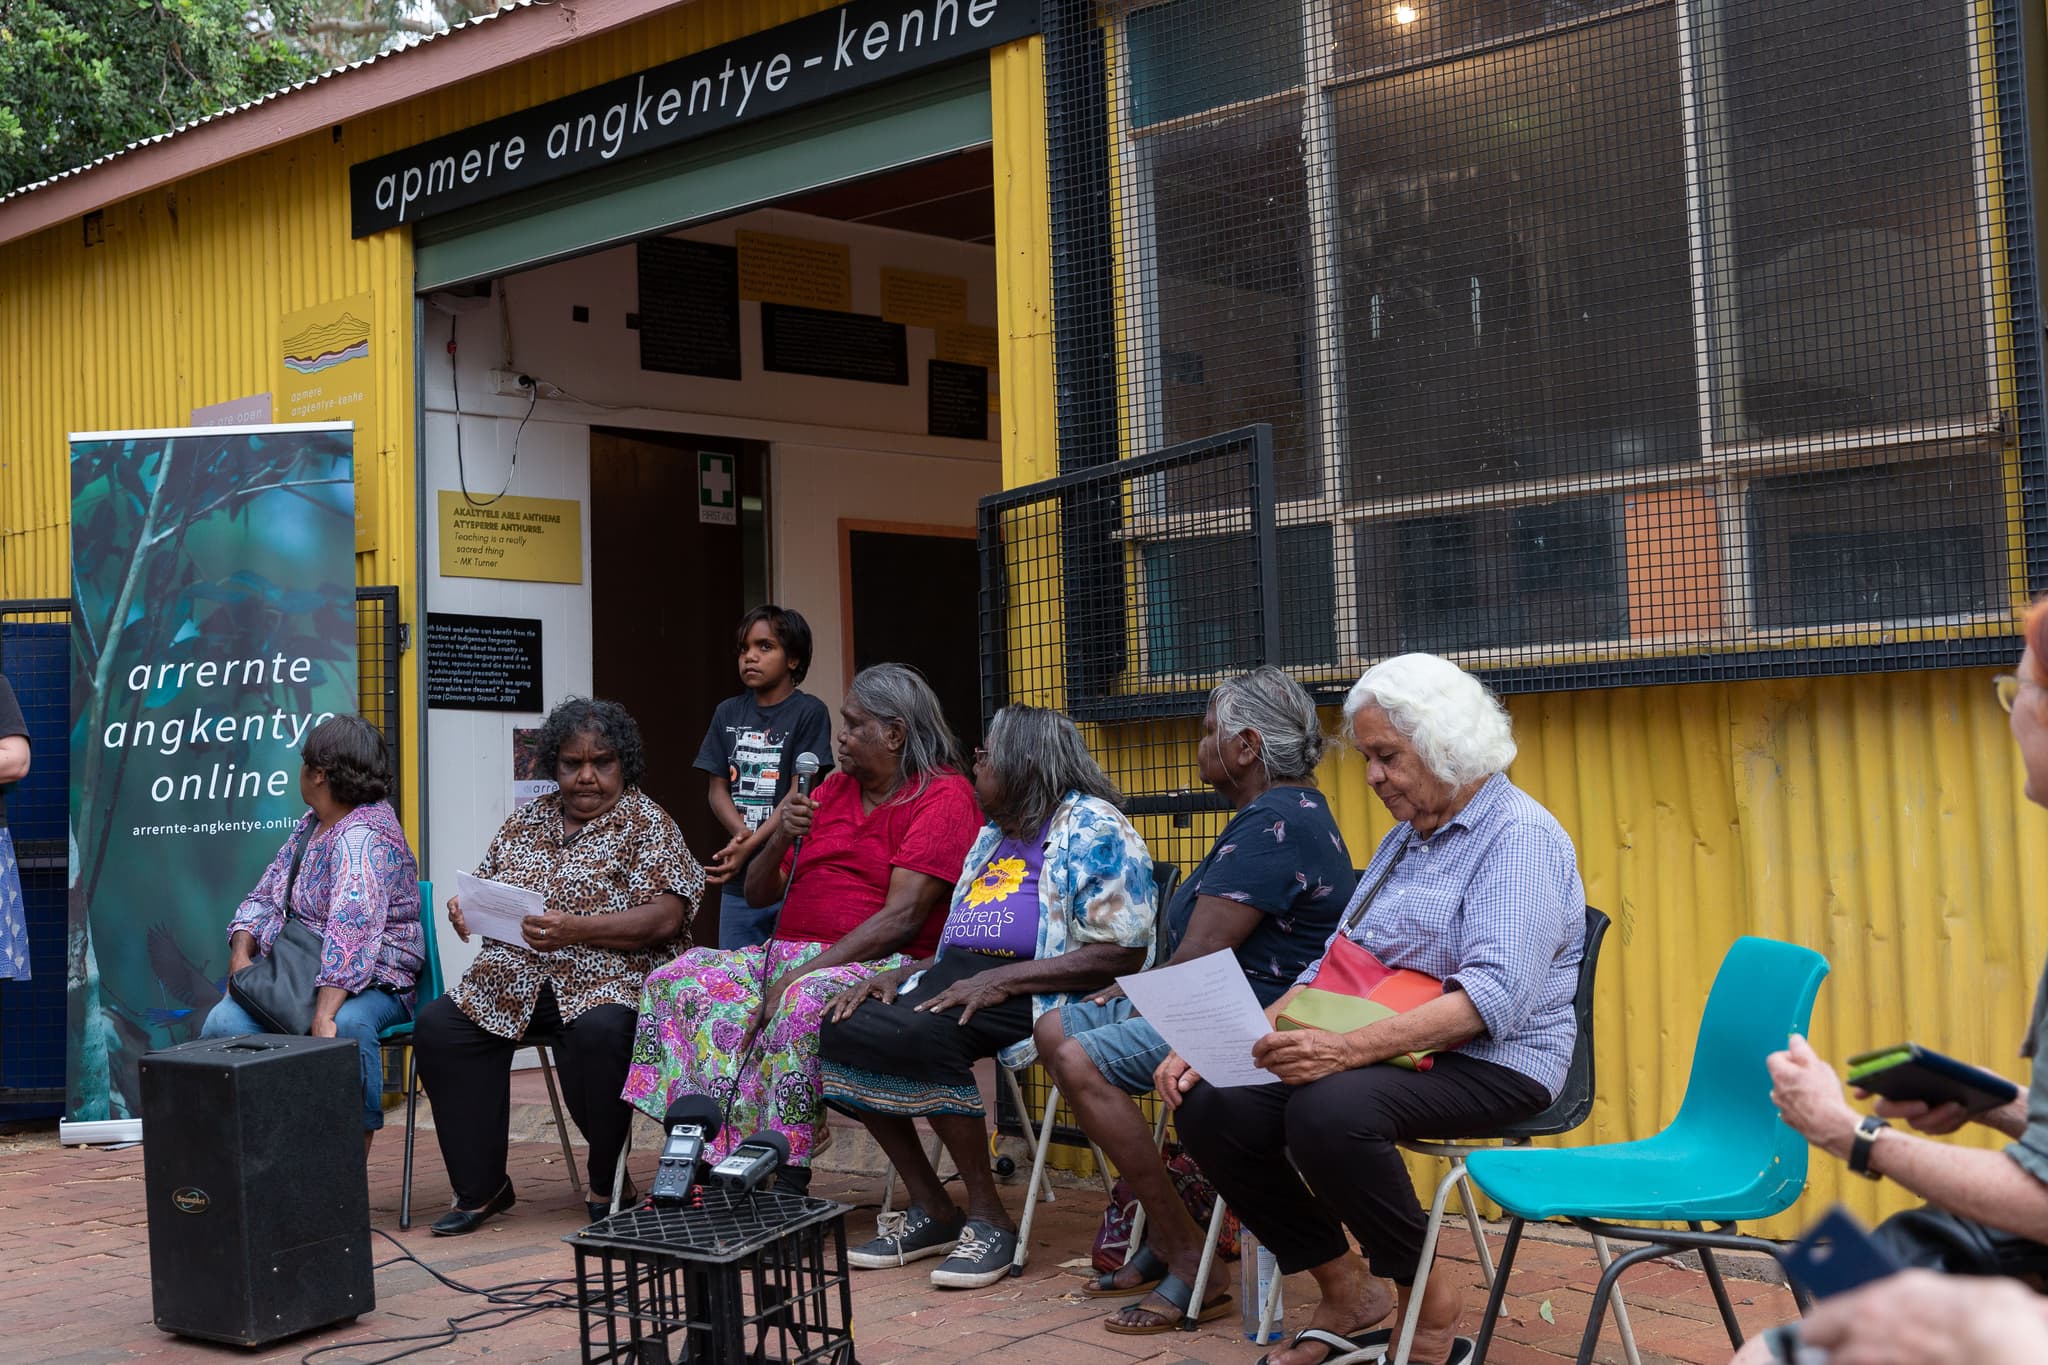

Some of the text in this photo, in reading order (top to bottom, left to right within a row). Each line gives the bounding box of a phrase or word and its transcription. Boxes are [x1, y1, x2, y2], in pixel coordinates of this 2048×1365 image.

[375, 135, 526, 222] apmere
[237, 409, 263, 423] open
[455, 532, 489, 545] Teaching
[505, 535, 527, 547] really
[456, 545, 504, 558] sacred thing
[460, 557, 472, 566] MK
[474, 558, 498, 568] Turner
[128, 652, 311, 691] arrernte
[151, 763, 289, 802] online
[944, 919, 1003, 943] ground
